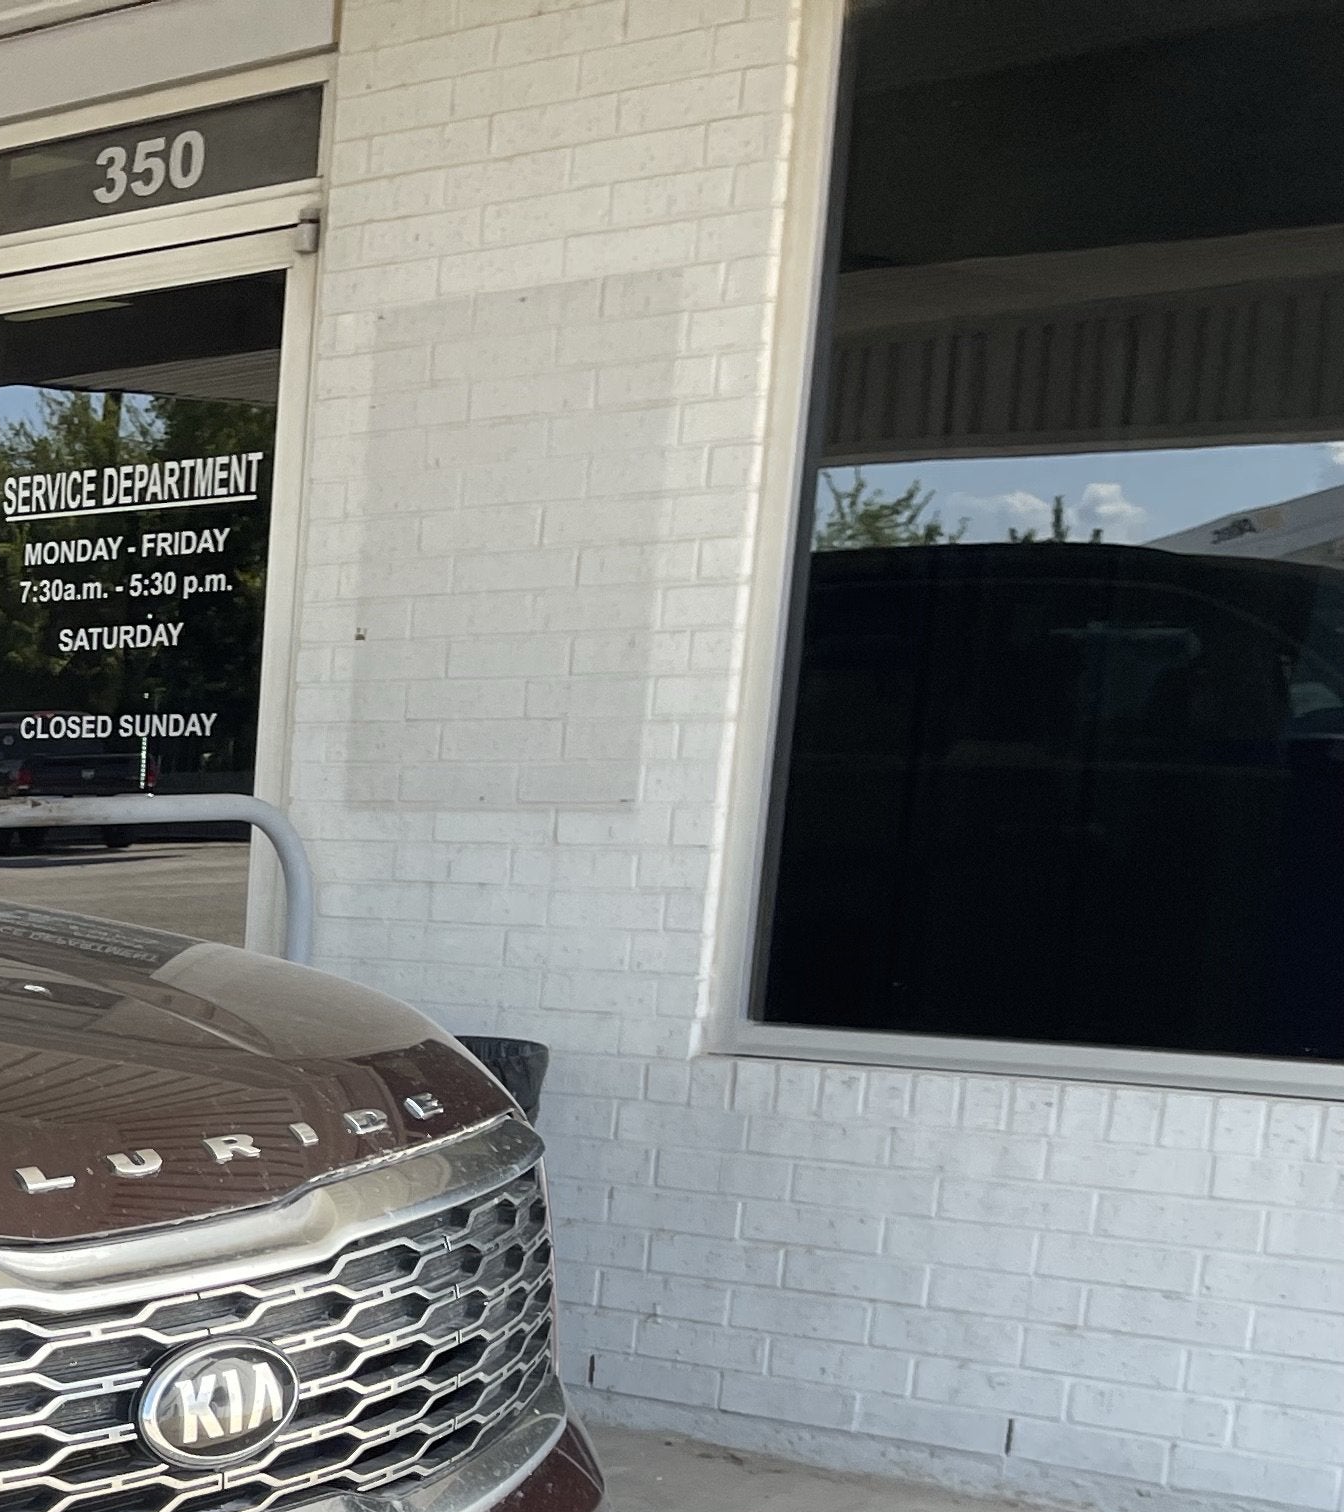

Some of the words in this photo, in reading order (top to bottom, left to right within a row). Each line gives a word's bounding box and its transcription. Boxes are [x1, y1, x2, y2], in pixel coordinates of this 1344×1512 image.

[93, 130, 205, 204] 350
[3, 469, 97, 515] SERVICE
[102, 451, 263, 506] DEPARTMENT
[24, 536, 124, 566] MONDAY
[141, 527, 231, 558] FRIDAY
[19, 579, 108, 603] 7:30a.m.
[129, 571, 177, 597] 5:30
[183, 573, 233, 600] p.m.
[58, 622, 184, 652] SATURDAY
[20, 715, 112, 739] CLOSED
[118, 712, 217, 738] SUNDAY
[174, 1361, 284, 1444] KIA
